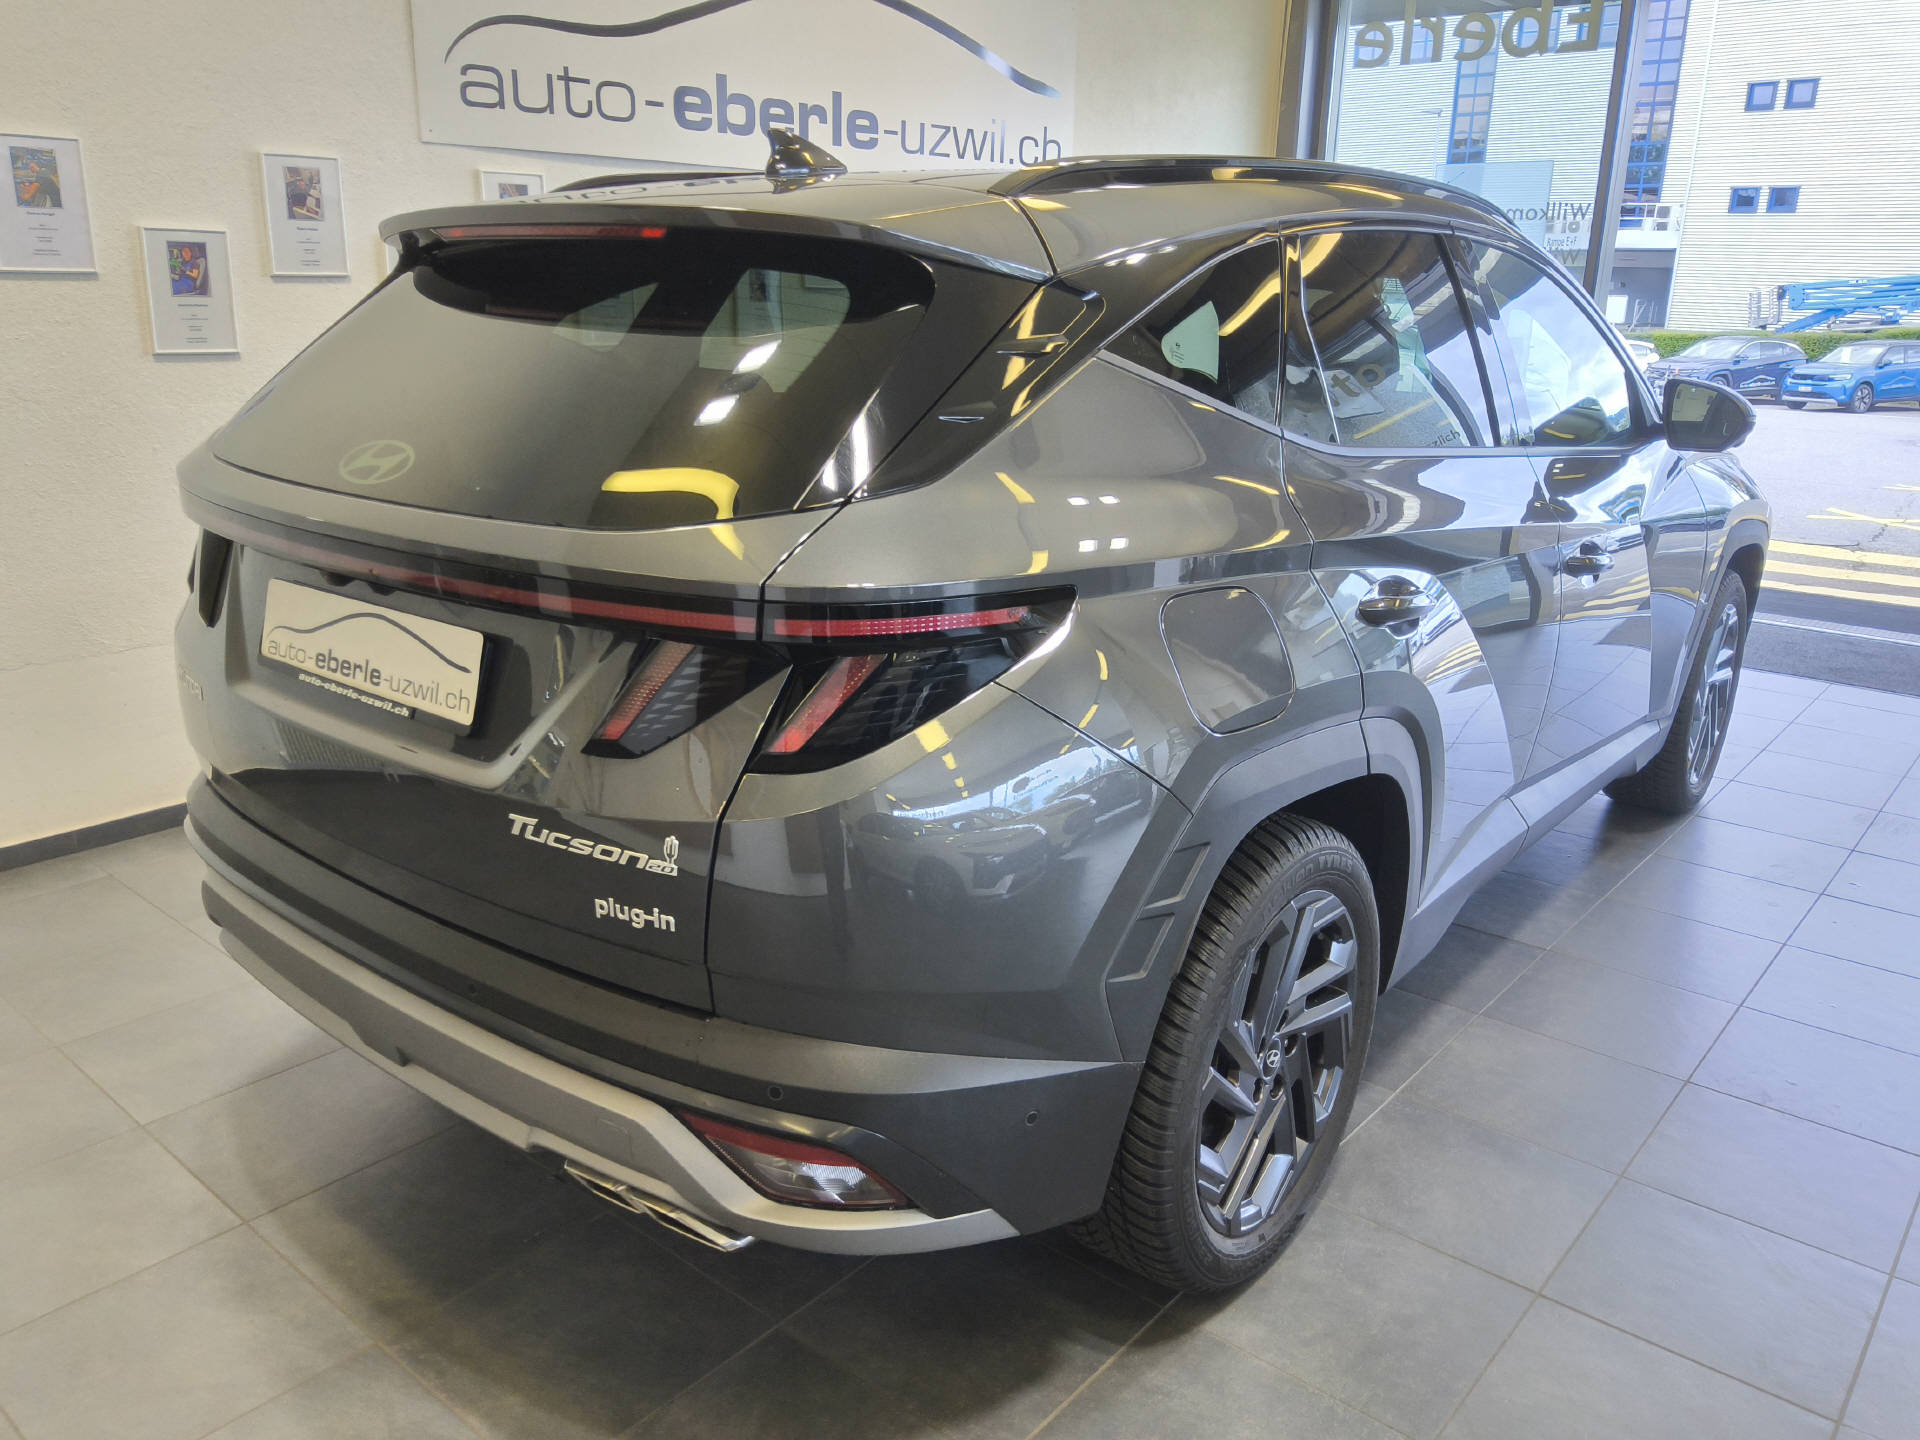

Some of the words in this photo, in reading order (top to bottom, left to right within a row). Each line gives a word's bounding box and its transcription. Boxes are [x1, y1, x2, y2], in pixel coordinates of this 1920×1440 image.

[460, 63, 1062, 167] auto-eberle-uzwil.ch
[267, 639, 470, 715] auto-eberle-uzwil.ch
[298, 672, 410, 719] auto-eberle-uzwil.ch
[508, 813, 650, 870] Tucson
[594, 897, 676, 932] plug-in
